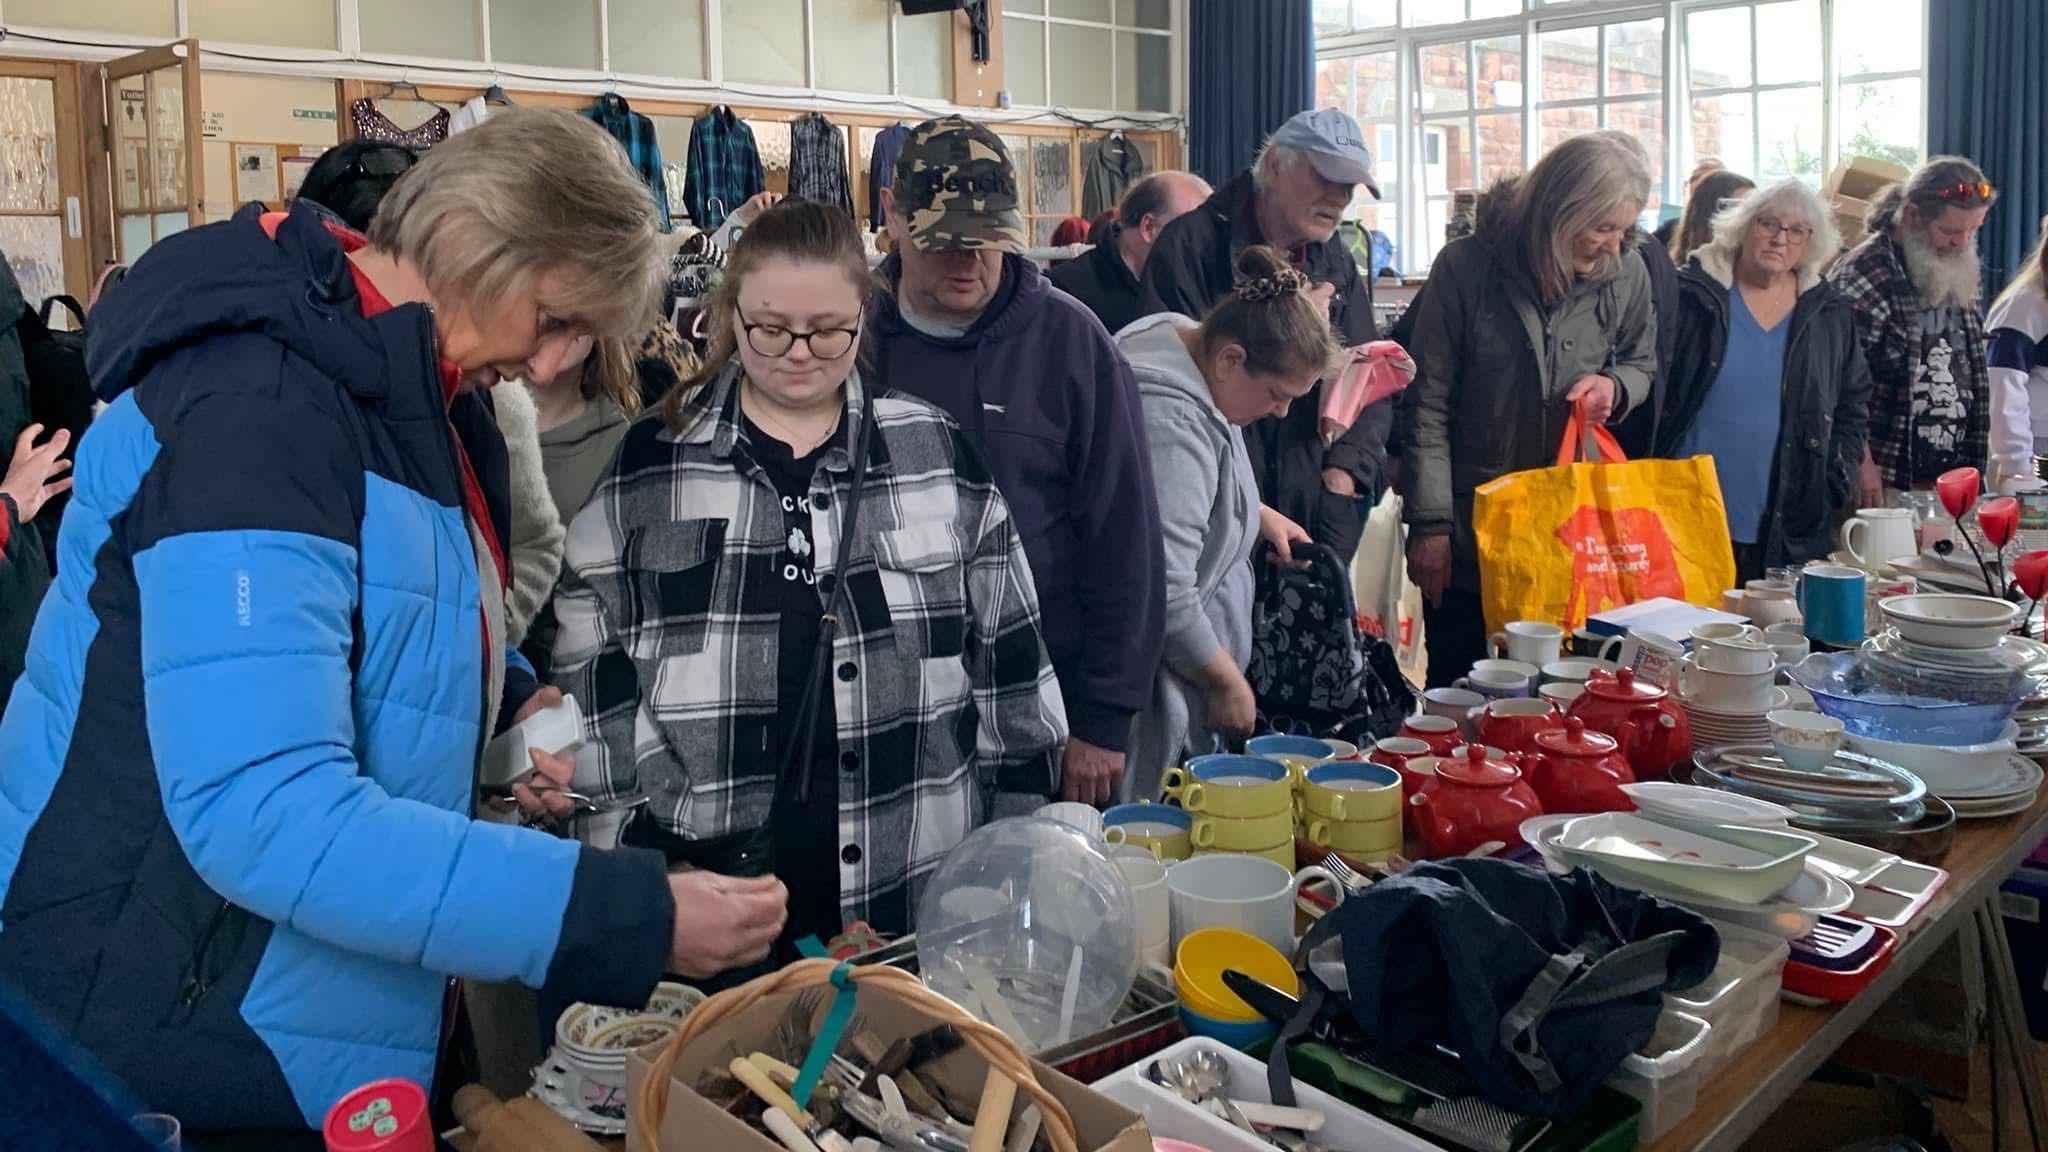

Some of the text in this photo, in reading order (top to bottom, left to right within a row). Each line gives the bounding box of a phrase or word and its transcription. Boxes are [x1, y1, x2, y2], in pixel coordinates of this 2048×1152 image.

[782, 496, 809, 514] CK
[1587, 556, 1608, 573] and
[783, 564, 815, 585] OU
[238, 575, 251, 626] RECCO
